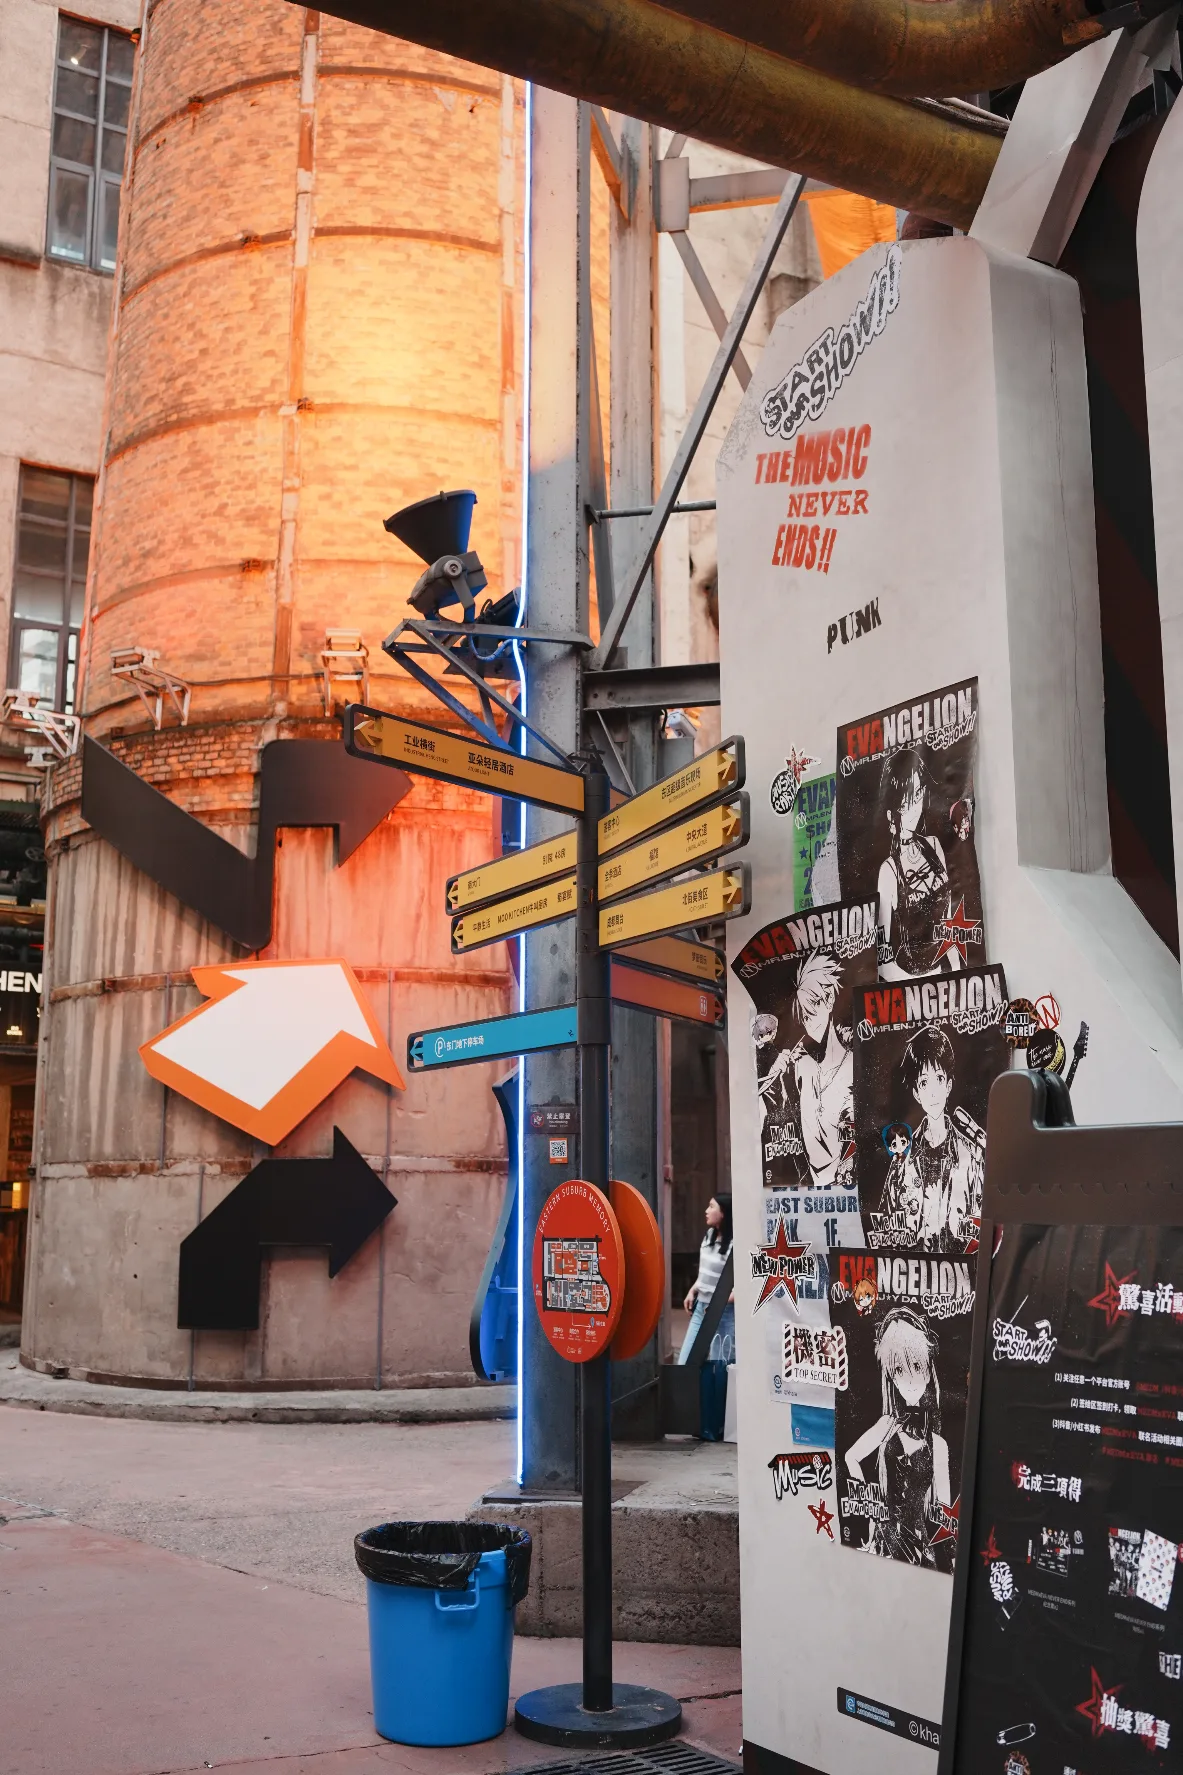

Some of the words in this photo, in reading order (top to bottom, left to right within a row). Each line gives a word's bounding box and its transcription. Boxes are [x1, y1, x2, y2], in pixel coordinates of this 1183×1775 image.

[764, 333, 832, 429] START
[755, 450, 793, 484] THE
[790, 423, 871, 487] MUSIC
[787, 489, 869, 518] NEVER
[772, 524, 838, 575] ENDS!!
[826, 597, 882, 654] PUNK
[846, 687, 972, 760] EVANGELION
[403, 733, 436, 754] 工业横街
[467, 751, 515, 777] 亚朵轻居酒店
[740, 901, 877, 965] EVANGELION
[952, 925, 983, 945] POWER
[863, 973, 1003, 1026] EVANGELION
[1005, 1020, 1038, 1037] BORED
[1006, 1009, 1029, 1025] ANTI
[446, 1034, 485, 1052] 东门地下停车场
[538, 1194, 561, 1234] EASTERN
[562, 1185, 588, 1198] SUBURB
[588, 1192, 611, 1233] MEMORY
[766, 1196, 801, 1214] EAST
[751, 1251, 779, 1278] NEW
[778, 1254, 815, 1279] POWER
[839, 1254, 972, 1299] EVANGELION
[922, 1292, 952, 1309] START
[993, 1317, 1028, 1341] START
[792, 1326, 838, 1369] 機密
[794, 1367, 809, 1379] TOP
[810, 1370, 838, 1384] SECRET
[1054, 1372, 1063, 1383] (1)
[1063, 1373, 1131, 1390] 关注任意一个平台官方账号
[1070, 1397, 1079, 1409] (2)
[1138, 1430, 1183, 1447] 联名活动相关图
[1017, 1464, 1082, 1503] 完成三項得
[1100, 1692, 1171, 1750] 抽獎驚喜
